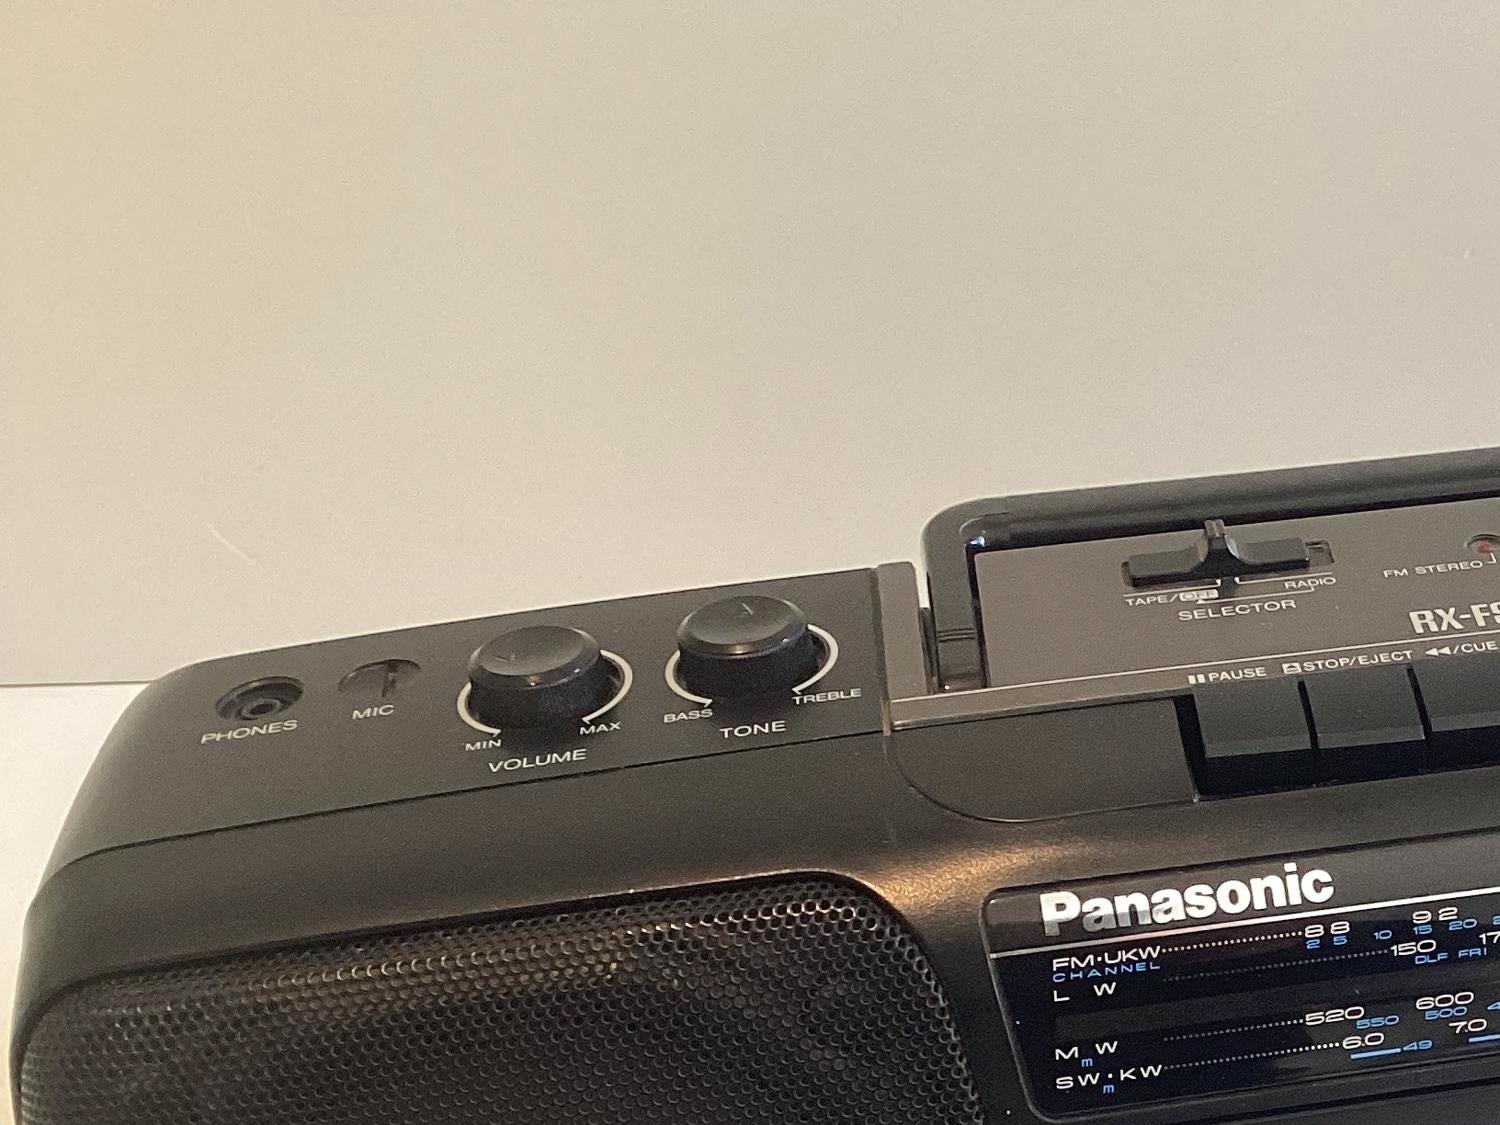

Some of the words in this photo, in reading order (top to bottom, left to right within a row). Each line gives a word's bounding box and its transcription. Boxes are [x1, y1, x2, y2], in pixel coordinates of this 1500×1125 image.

[1383, 567, 1409, 579] FM
[1414, 559, 1484, 576] STEREO
[1284, 576, 1337, 591] RADIO
[1178, 598, 1297, 622] SELECTOR
[1303, 650, 1414, 673] STOP/EJECT
[1208, 666, 1267, 683] PAUSE
[352, 704, 396, 720] MIC
[663, 708, 714, 723] BASS
[793, 688, 862, 706] TREBLE
[201, 718, 299, 745] PHONES
[465, 738, 502, 752] MIN
[579, 720, 622, 737] MAX
[719, 720, 787, 740] TONE
[488, 748, 588, 774] VOLUME
[1039, 862, 1335, 937] Panasonic
[1052, 962, 1161, 983] CHANNEL
[1306, 938, 1322, 949] 2
[1333, 935, 1349, 946] 5
[1373, 929, 1393, 941] 10
[1413, 924, 1433, 935] 15
[1448, 919, 1478, 931] 20
[1391, 939, 1437, 956] 150
[1415, 952, 1448, 965] DLF
[1305, 1006, 1365, 1026] 520
[1415, 991, 1474, 1010] 600
[1356, 1015, 1400, 1029] 550
[1424, 1006, 1468, 1020] 500
[1342, 1032, 1385, 1050] 6.0
[1450, 1017, 1488, 1034] 7.0
[1403, 1039, 1434, 1052] 49
